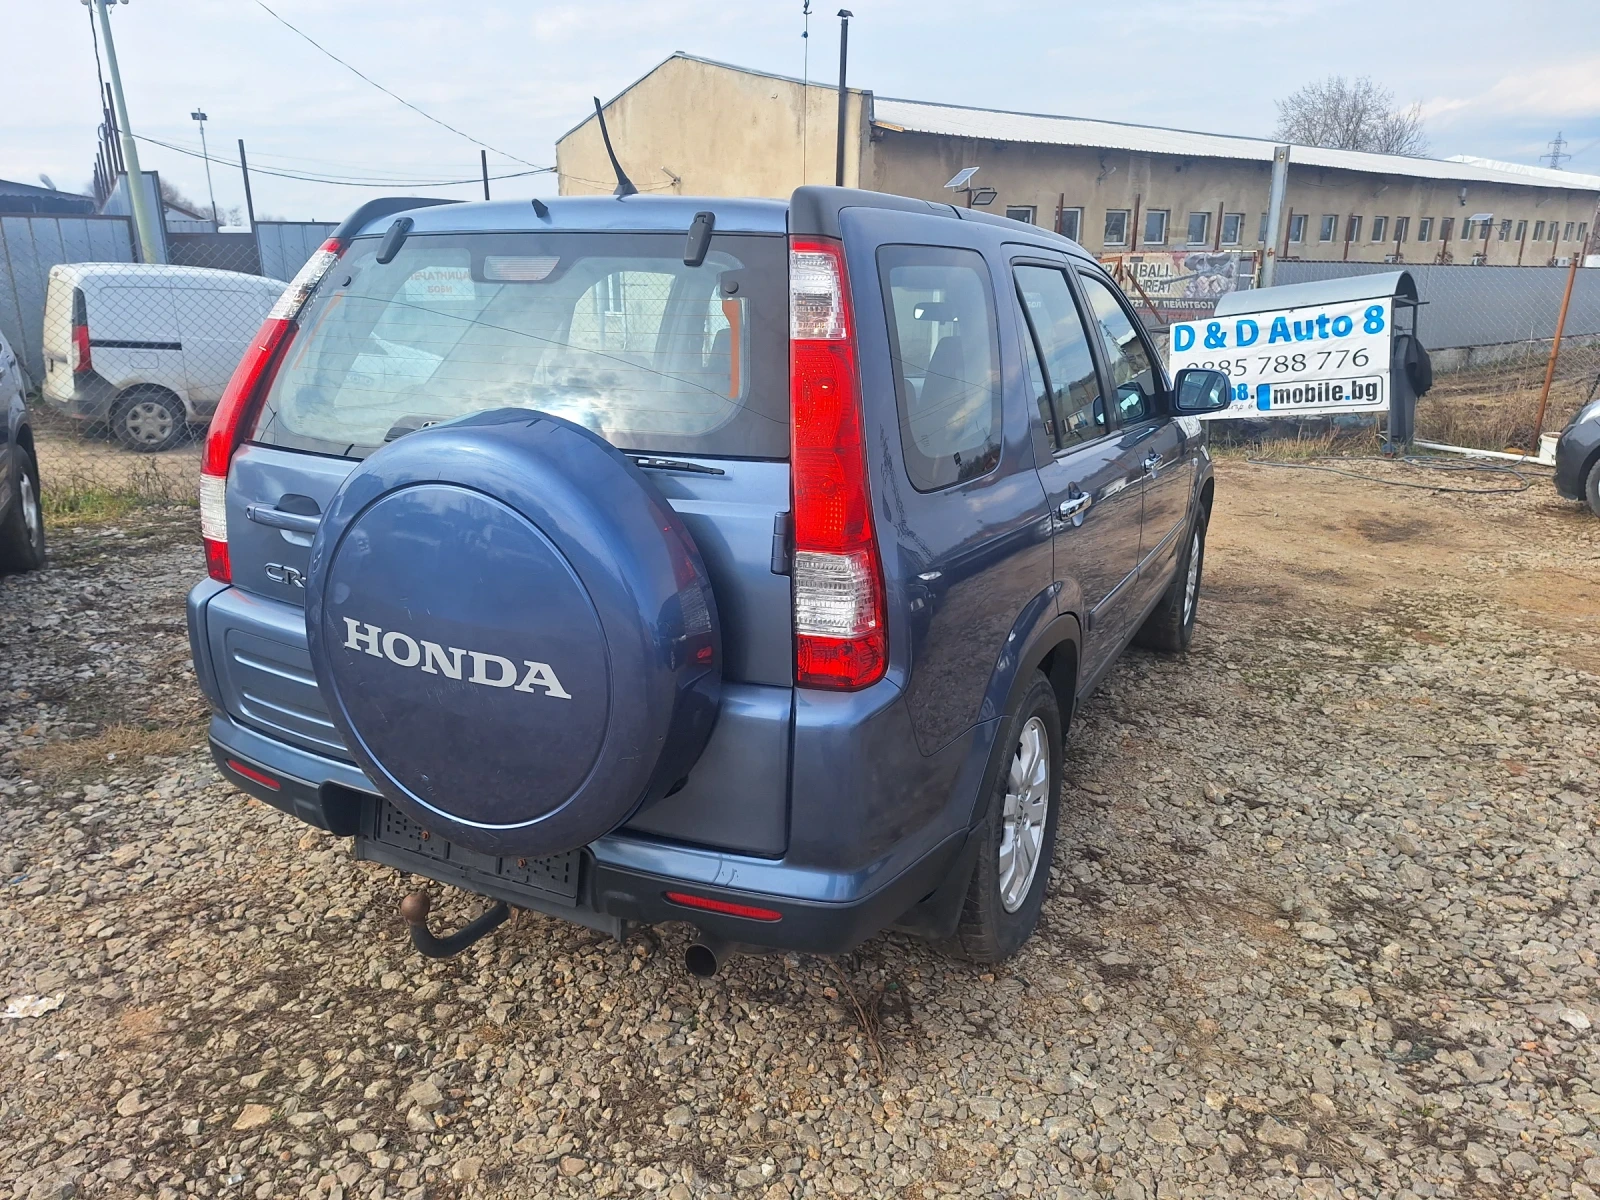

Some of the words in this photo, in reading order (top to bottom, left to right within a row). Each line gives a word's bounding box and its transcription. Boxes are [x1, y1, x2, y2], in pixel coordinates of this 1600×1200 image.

[1162, 298, 1215, 310] ПЕЙНТБОЛ
[1174, 324, 1196, 352] D
[1203, 321, 1227, 350] &
[1236, 319, 1259, 347] D
[1268, 313, 1354, 345] Auto
[1363, 305, 1385, 335] 8
[1257, 353, 1307, 376] 788
[1316, 347, 1370, 371] 776
[1272, 380, 1378, 404] mobile.bg
[342, 616, 572, 700] HONDA
